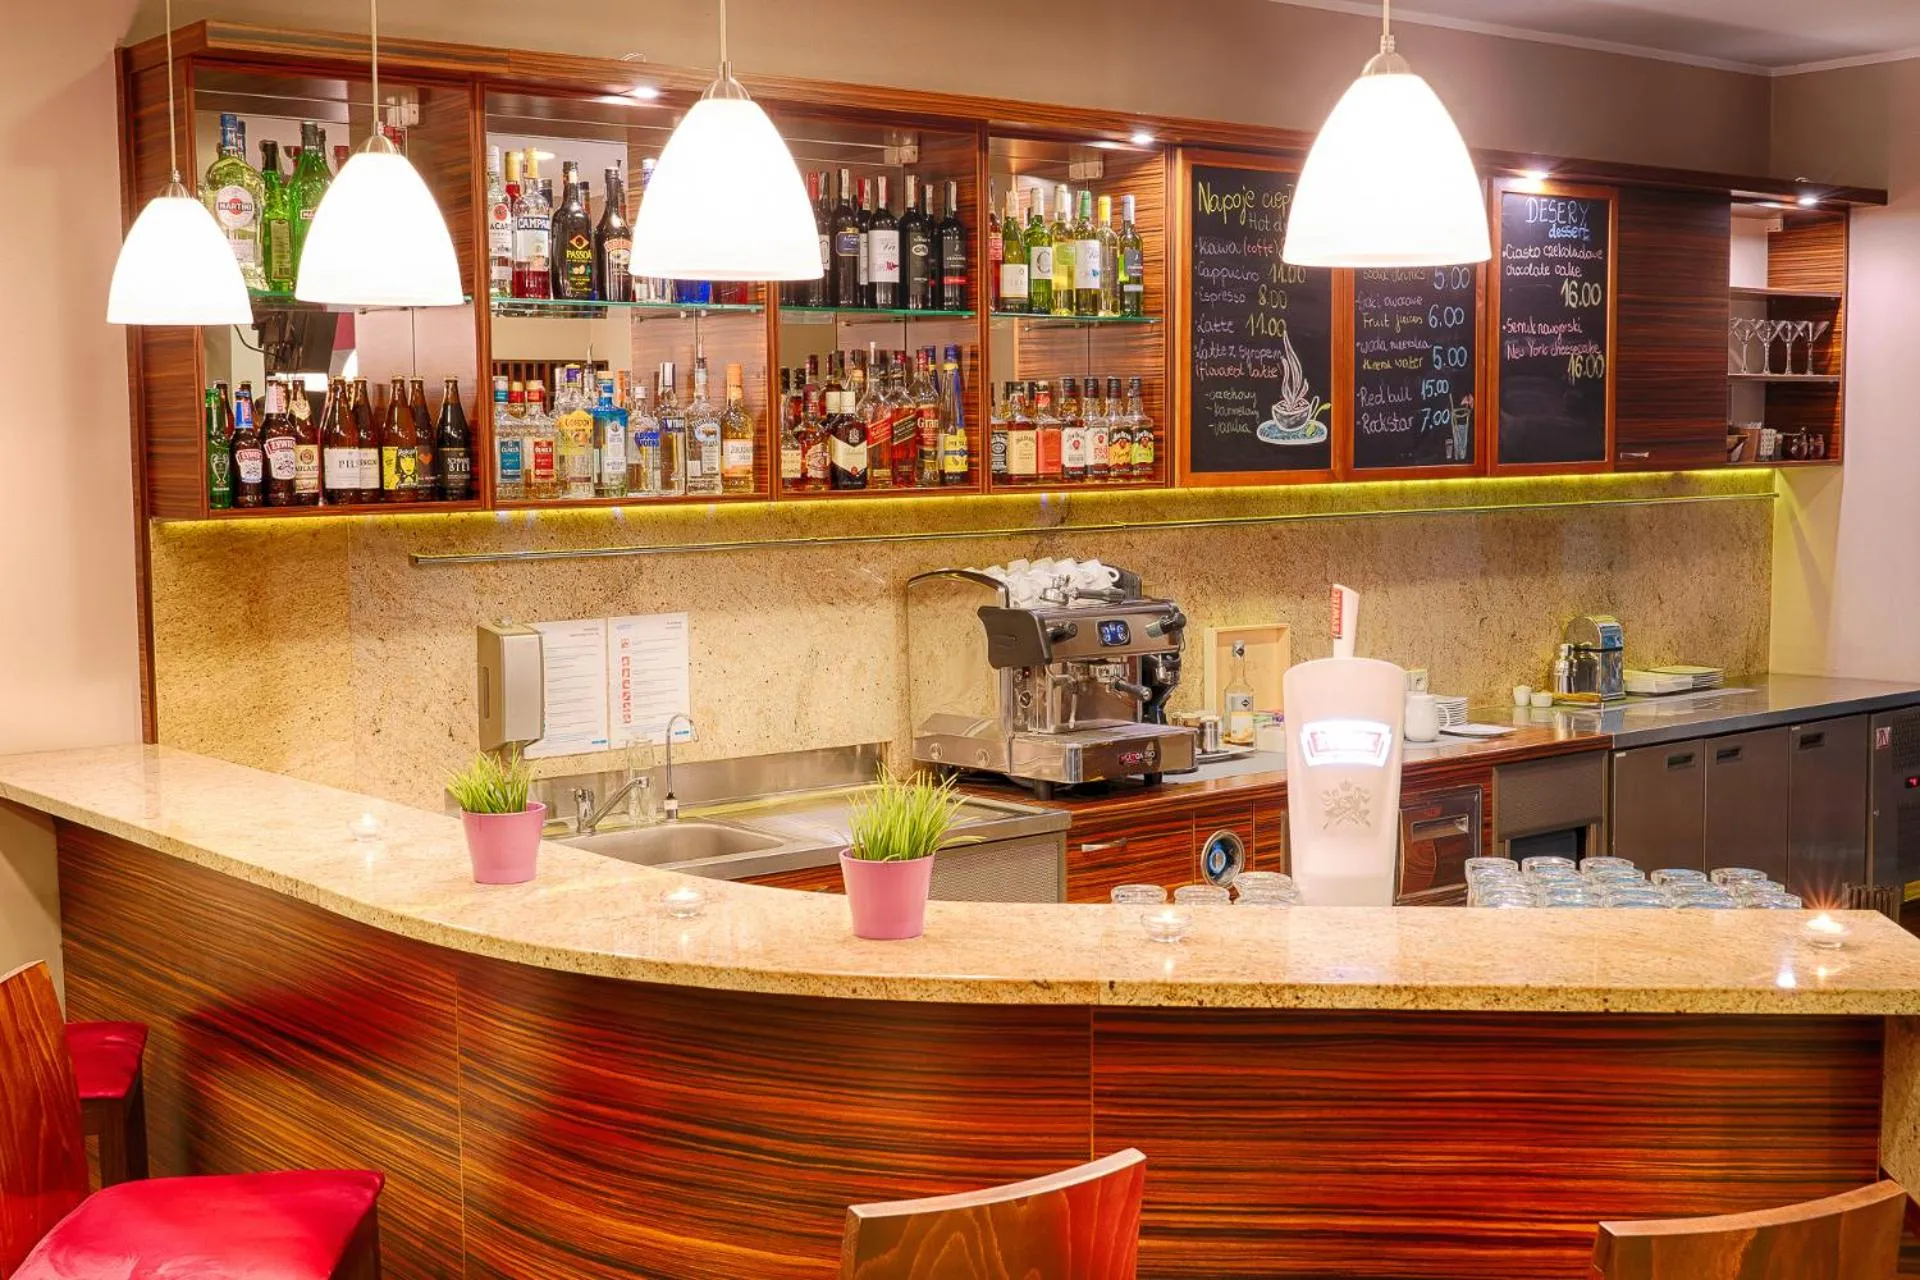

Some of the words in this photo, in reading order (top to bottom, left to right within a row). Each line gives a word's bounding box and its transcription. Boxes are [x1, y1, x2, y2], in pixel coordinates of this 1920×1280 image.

[218, 202, 253, 212] MARTINI
[1198, 181, 1255, 225] Napoje
[1525, 197, 1589, 225] DESERY
[1433, 266, 1470, 290] 5.00
[1258, 283, 1288, 309] 8.00
[1560, 278, 1602, 308] 16.00
[1245, 312, 1287, 337] 11.00
[1429, 304, 1464, 328] 6.00
[1433, 345, 1467, 370] 5.00
[1567, 353, 1604, 379] 16.00
[1421, 408, 1450, 432] 7.00
